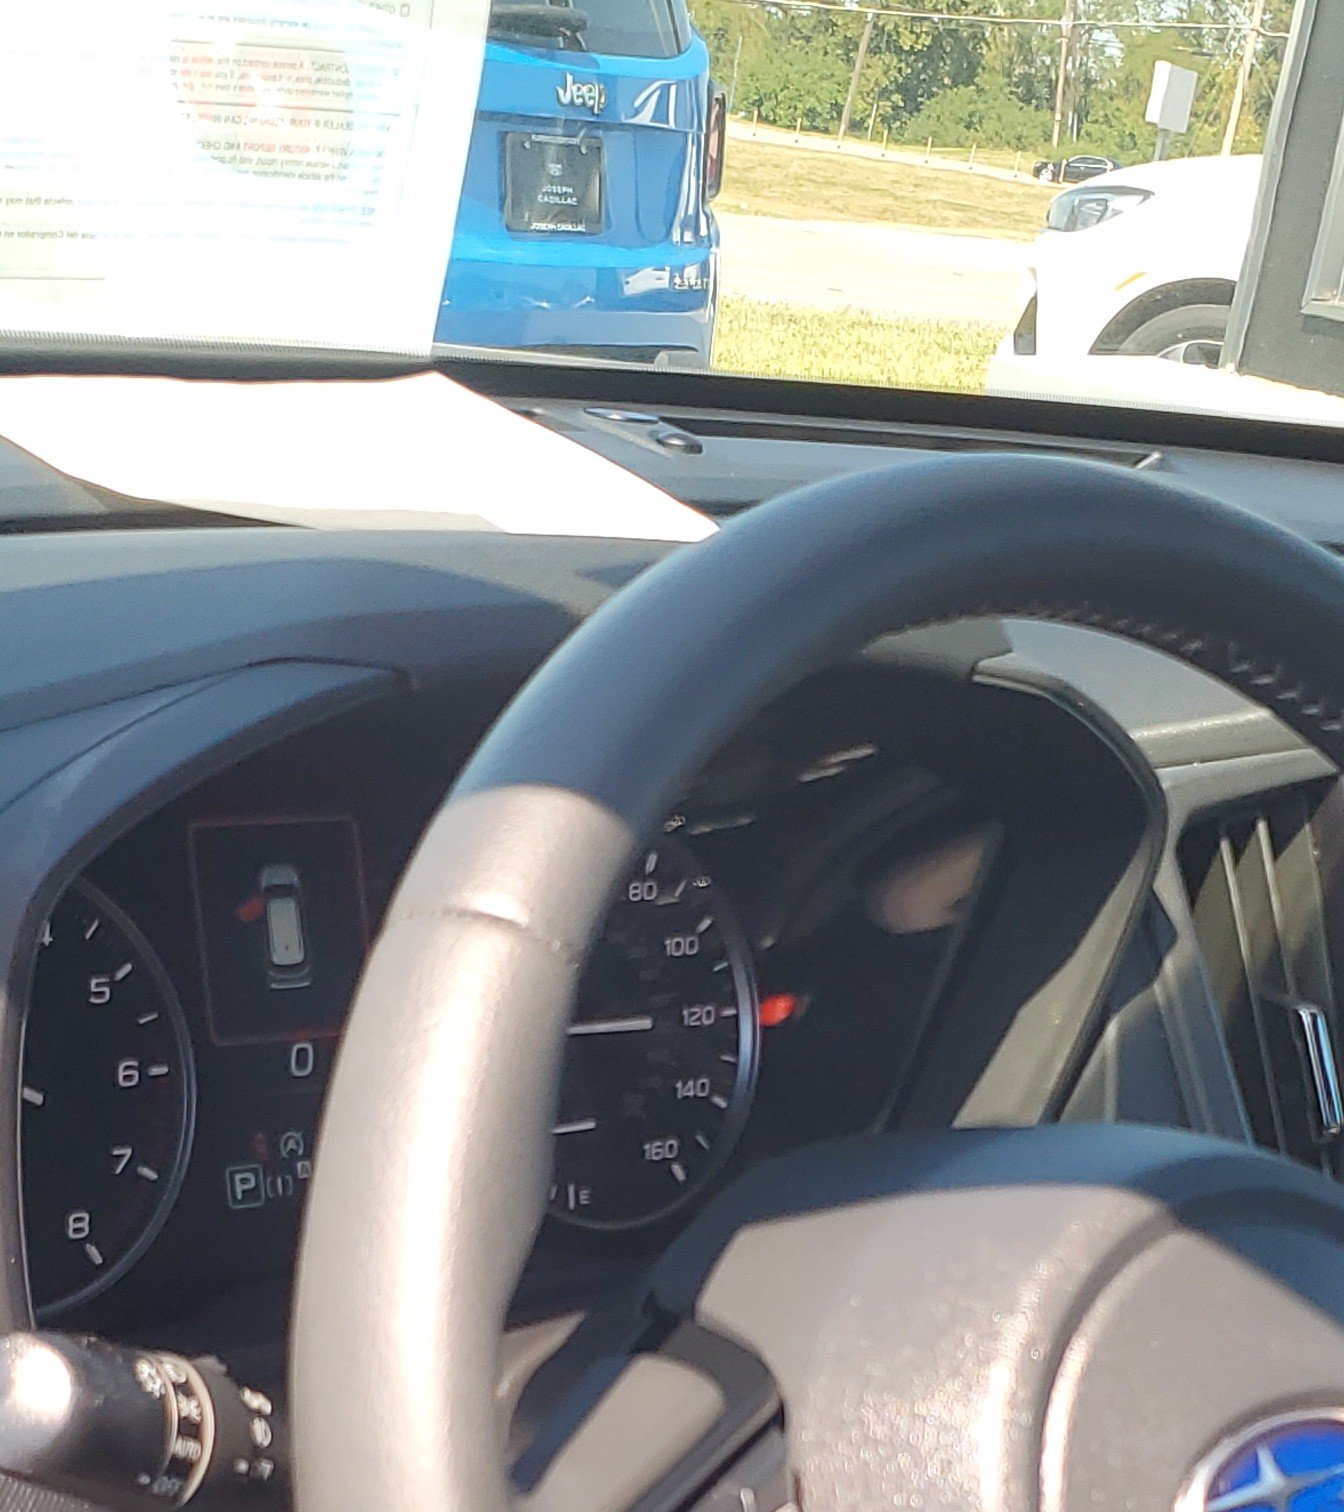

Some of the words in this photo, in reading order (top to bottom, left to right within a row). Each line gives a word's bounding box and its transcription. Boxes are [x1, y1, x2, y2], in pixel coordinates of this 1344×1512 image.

[556, 71, 607, 115] Jeep
[628, 882, 657, 903] 80
[664, 935, 700, 958] 100
[88, 976, 112, 1005] 5
[682, 1005, 716, 1027] 120
[117, 1059, 140, 1088] 6
[290, 1042, 315, 1078] 0
[675, 1078, 711, 1100] 140
[110, 1145, 134, 1176] 7
[642, 1139, 680, 1161] 160
[233, 1171, 257, 1201] P
[578, 1188, 592, 1205] E
[67, 1210, 91, 1241] 8
